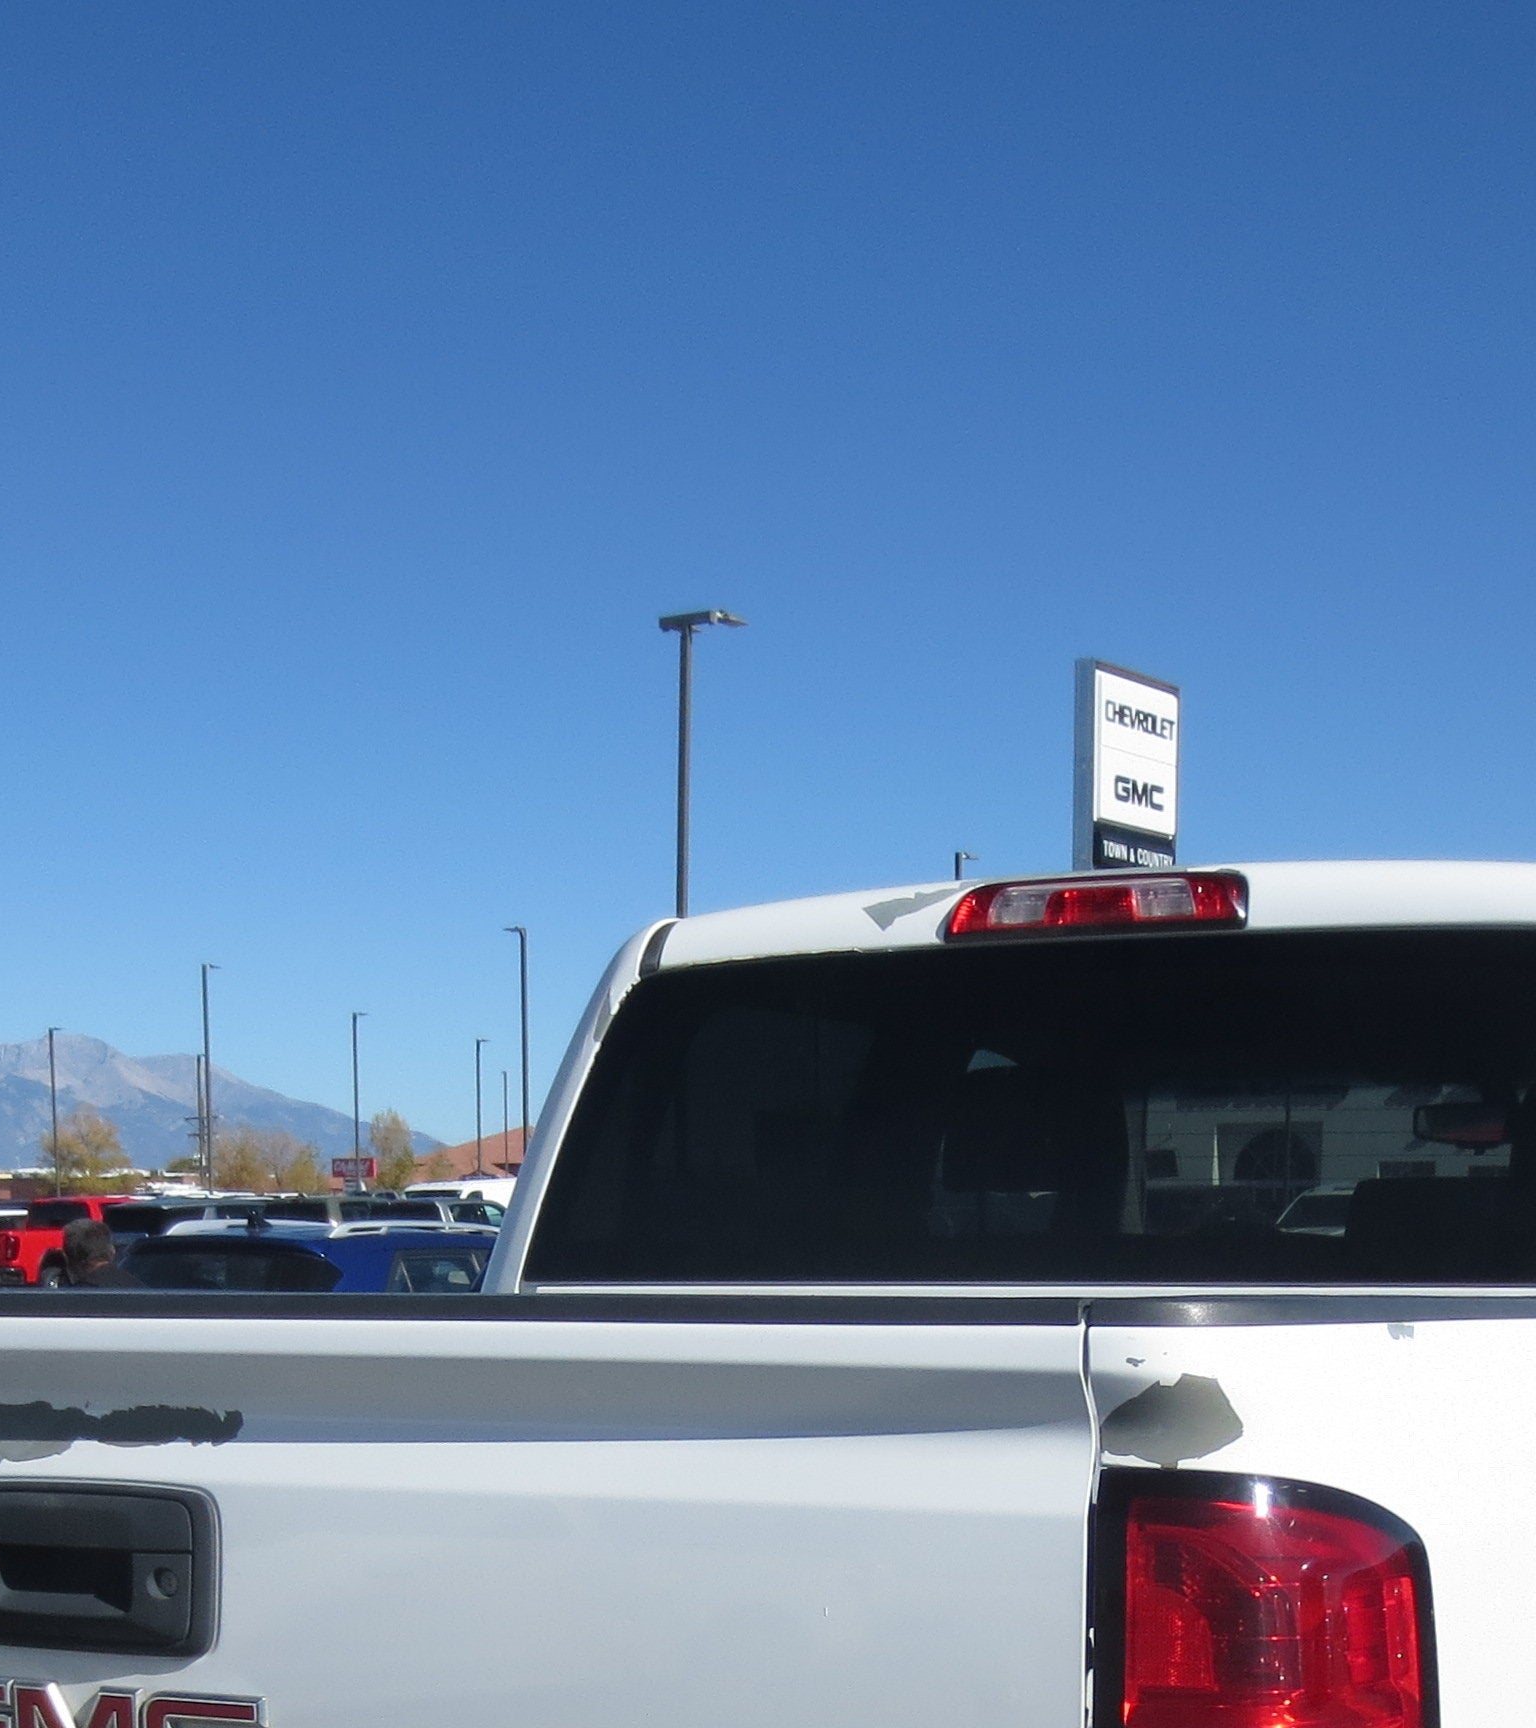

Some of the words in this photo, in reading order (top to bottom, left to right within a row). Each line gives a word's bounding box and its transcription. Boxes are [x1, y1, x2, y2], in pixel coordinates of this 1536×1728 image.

[1104, 699, 1176, 742] CHEVROLET
[1114, 774, 1164, 812] GMC
[1103, 839, 1128, 862] TOWN
[1137, 847, 1174, 867] COUNTRY
